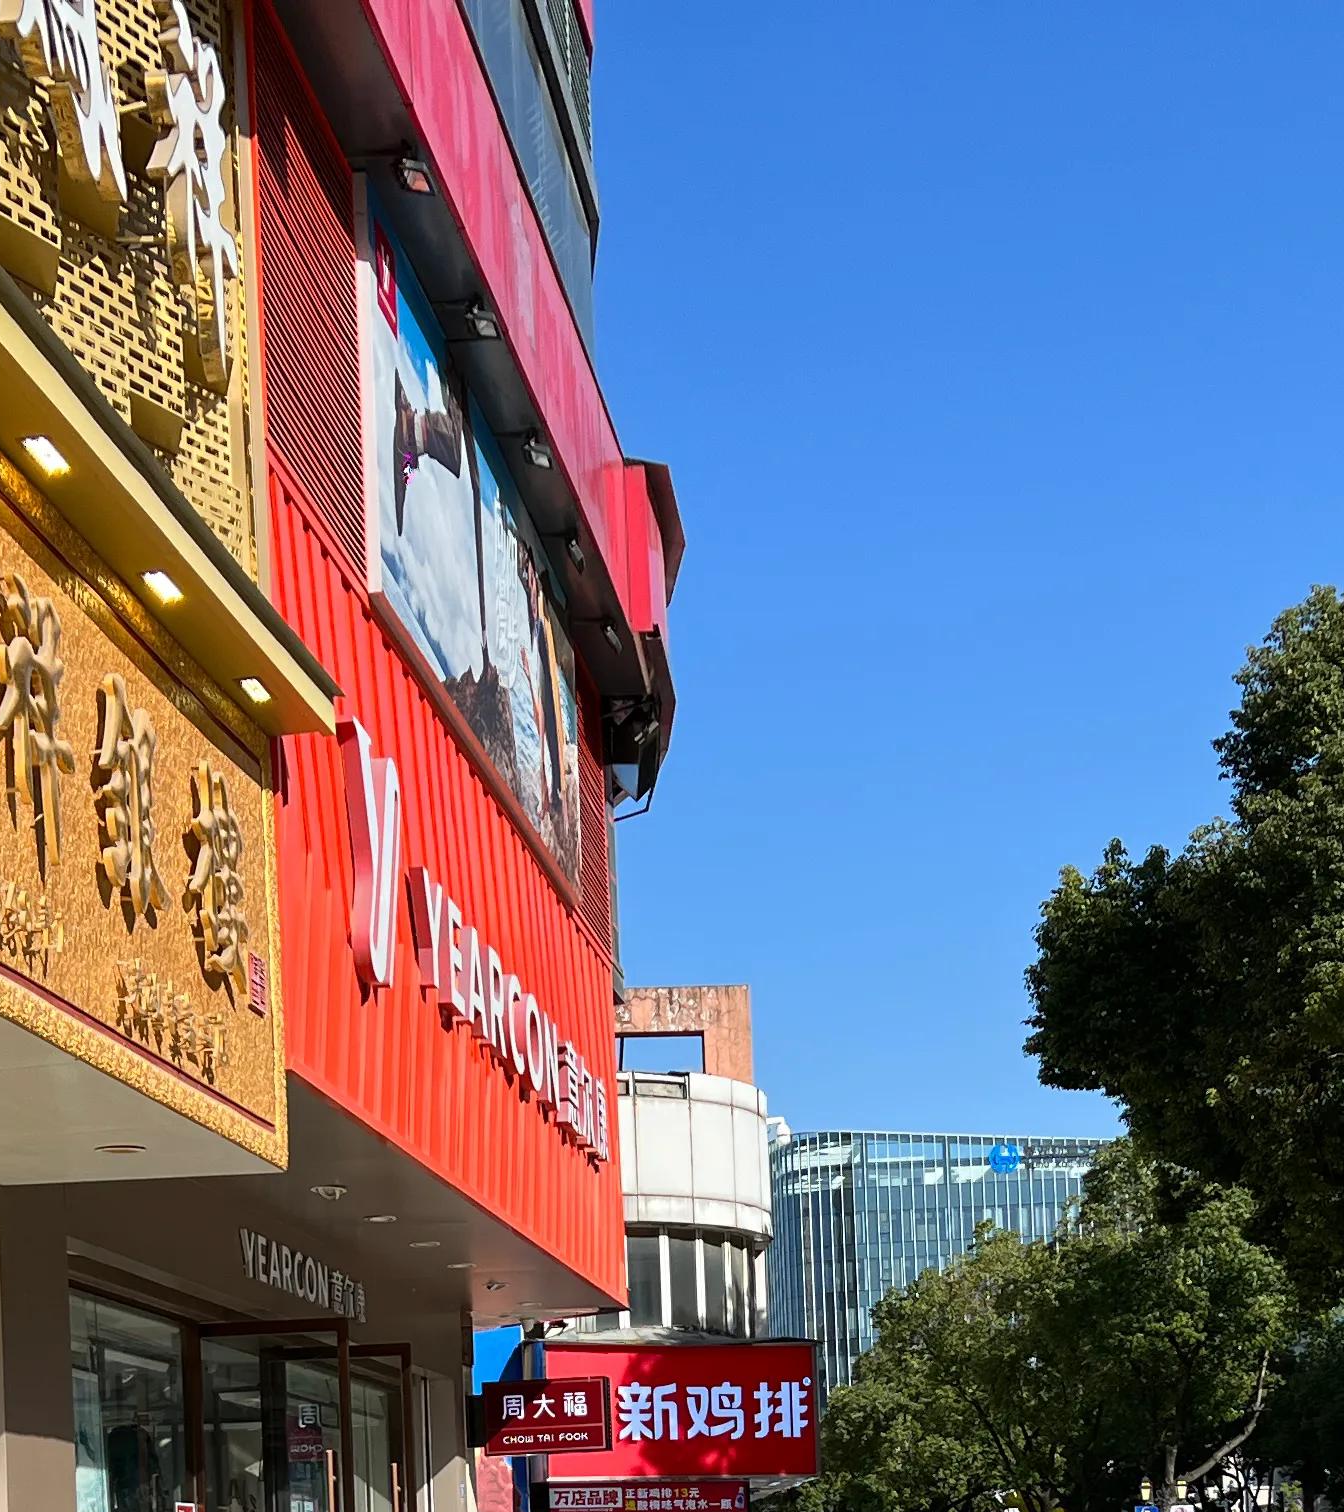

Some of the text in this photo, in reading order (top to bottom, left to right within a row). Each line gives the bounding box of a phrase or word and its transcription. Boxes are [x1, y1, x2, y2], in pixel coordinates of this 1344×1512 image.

[413, 866, 562, 1112] YEARCON
[239, 1226, 332, 1308] YEARCON
[502, 1391, 588, 1420] 周大福
[618, 1381, 809, 1441] 新鸡排
[503, 1432, 589, 1445] CHOW TAI FOOK
[554, 1489, 619, 1506] 万店品牌
